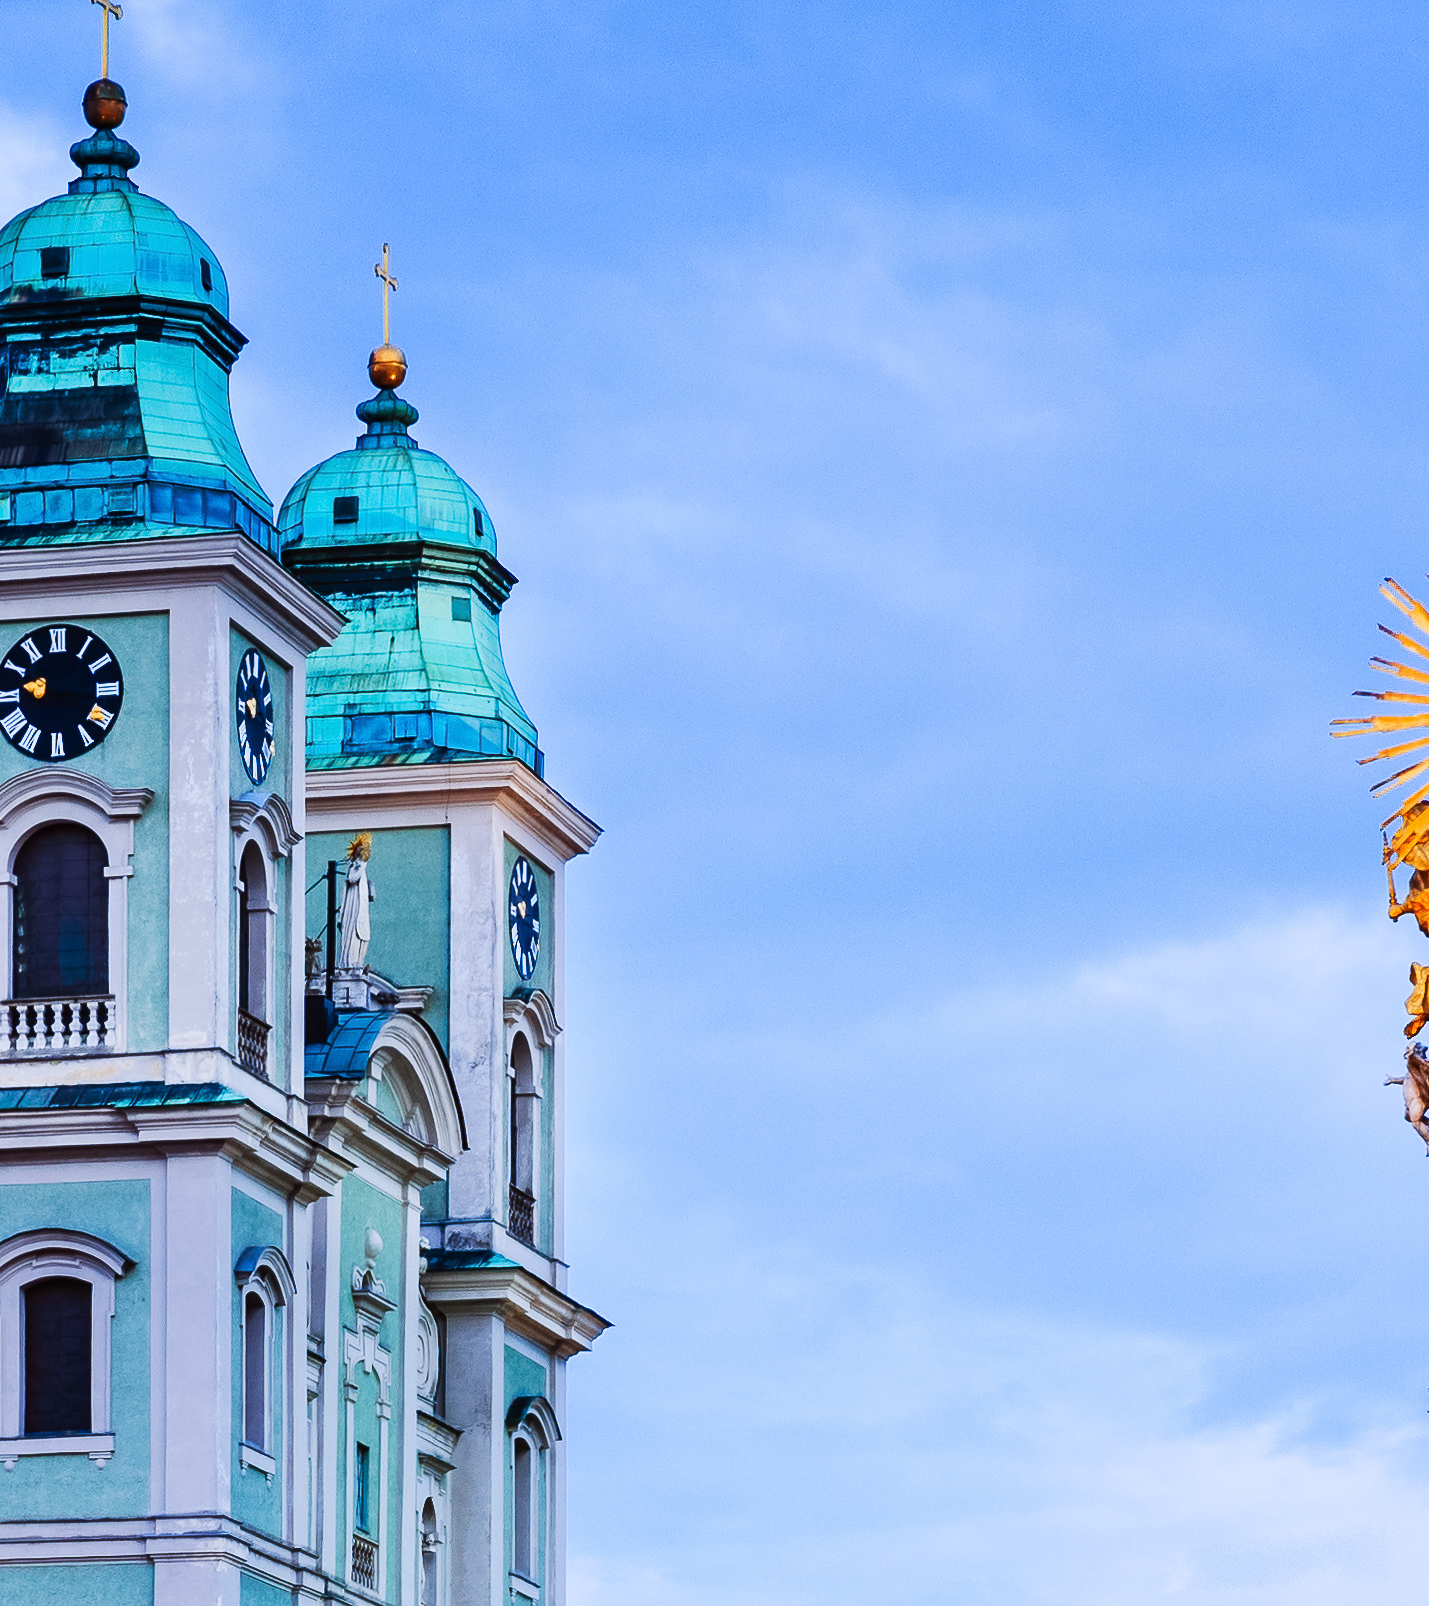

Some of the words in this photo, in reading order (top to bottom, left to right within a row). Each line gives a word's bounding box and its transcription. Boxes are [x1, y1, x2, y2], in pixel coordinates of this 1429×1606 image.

[20, 637, 43, 664] XI
[49, 628, 67, 653] XII
[4, 659, 26, 677] X
[96, 681, 119, 697] III
